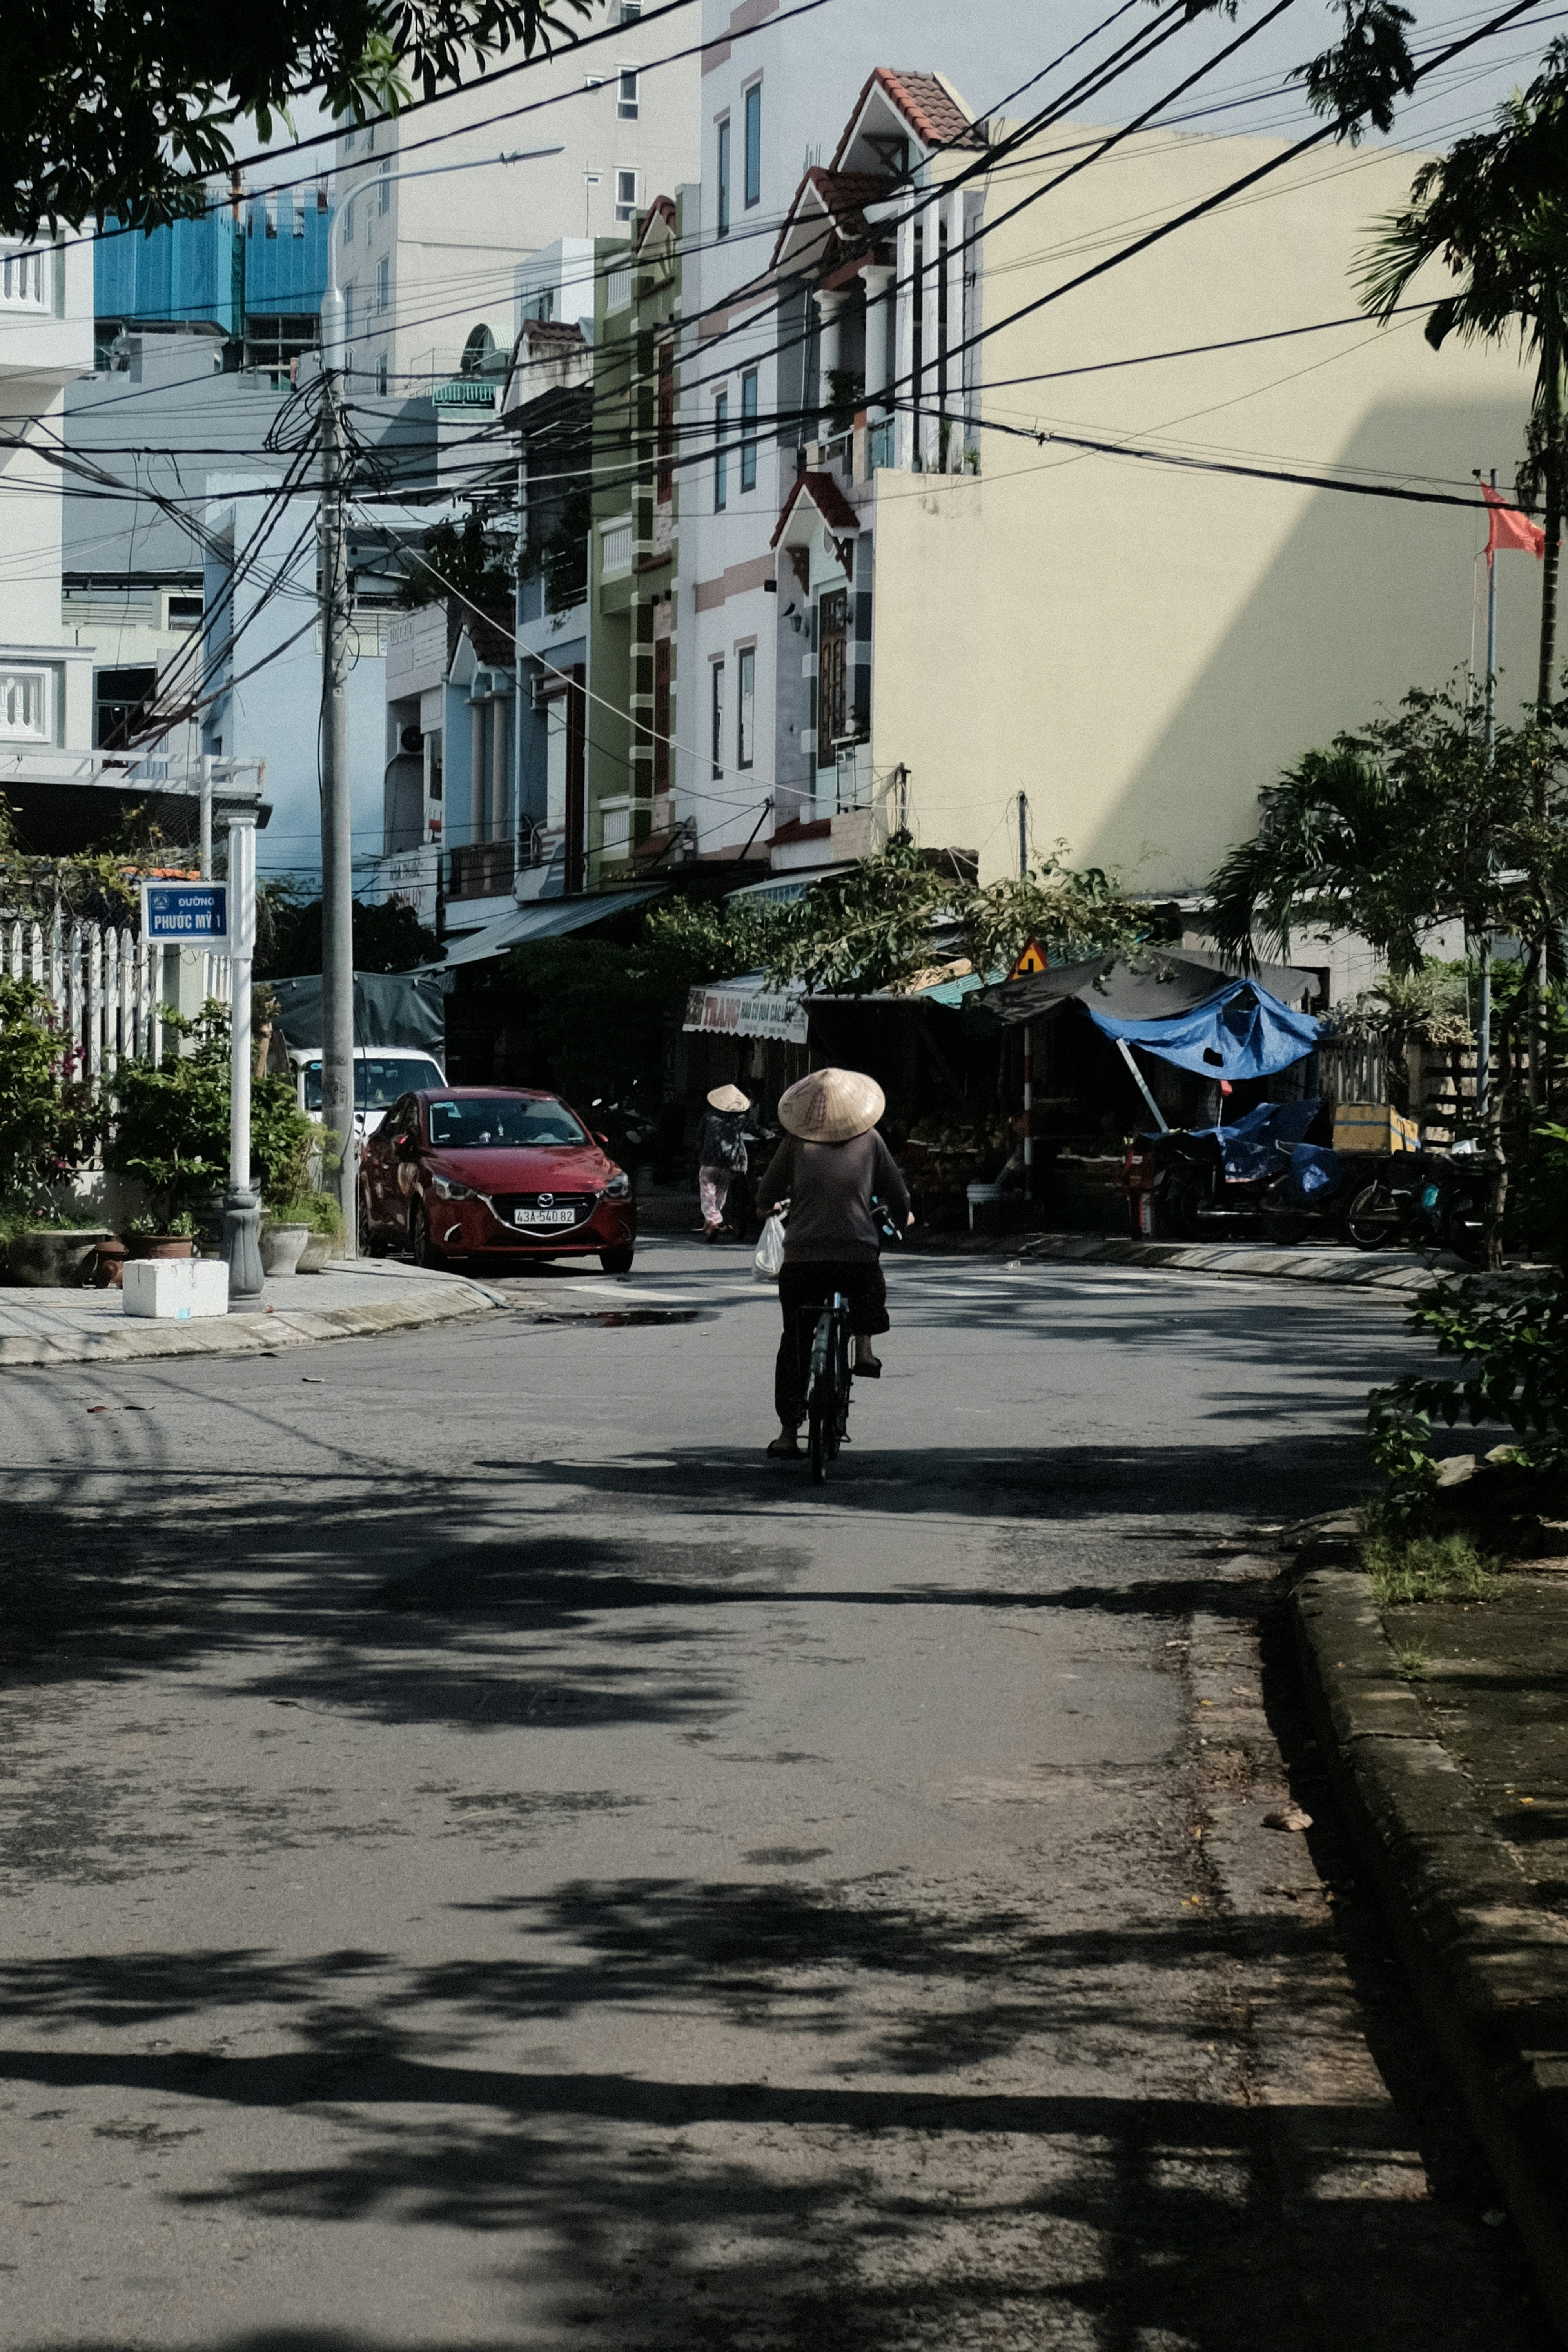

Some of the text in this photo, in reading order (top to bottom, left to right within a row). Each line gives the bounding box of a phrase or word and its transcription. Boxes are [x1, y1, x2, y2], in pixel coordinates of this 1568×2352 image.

[178, 896, 215, 907] ĐƯỜNG
[154, 910, 220, 929] PHƯỚC MỸ 1
